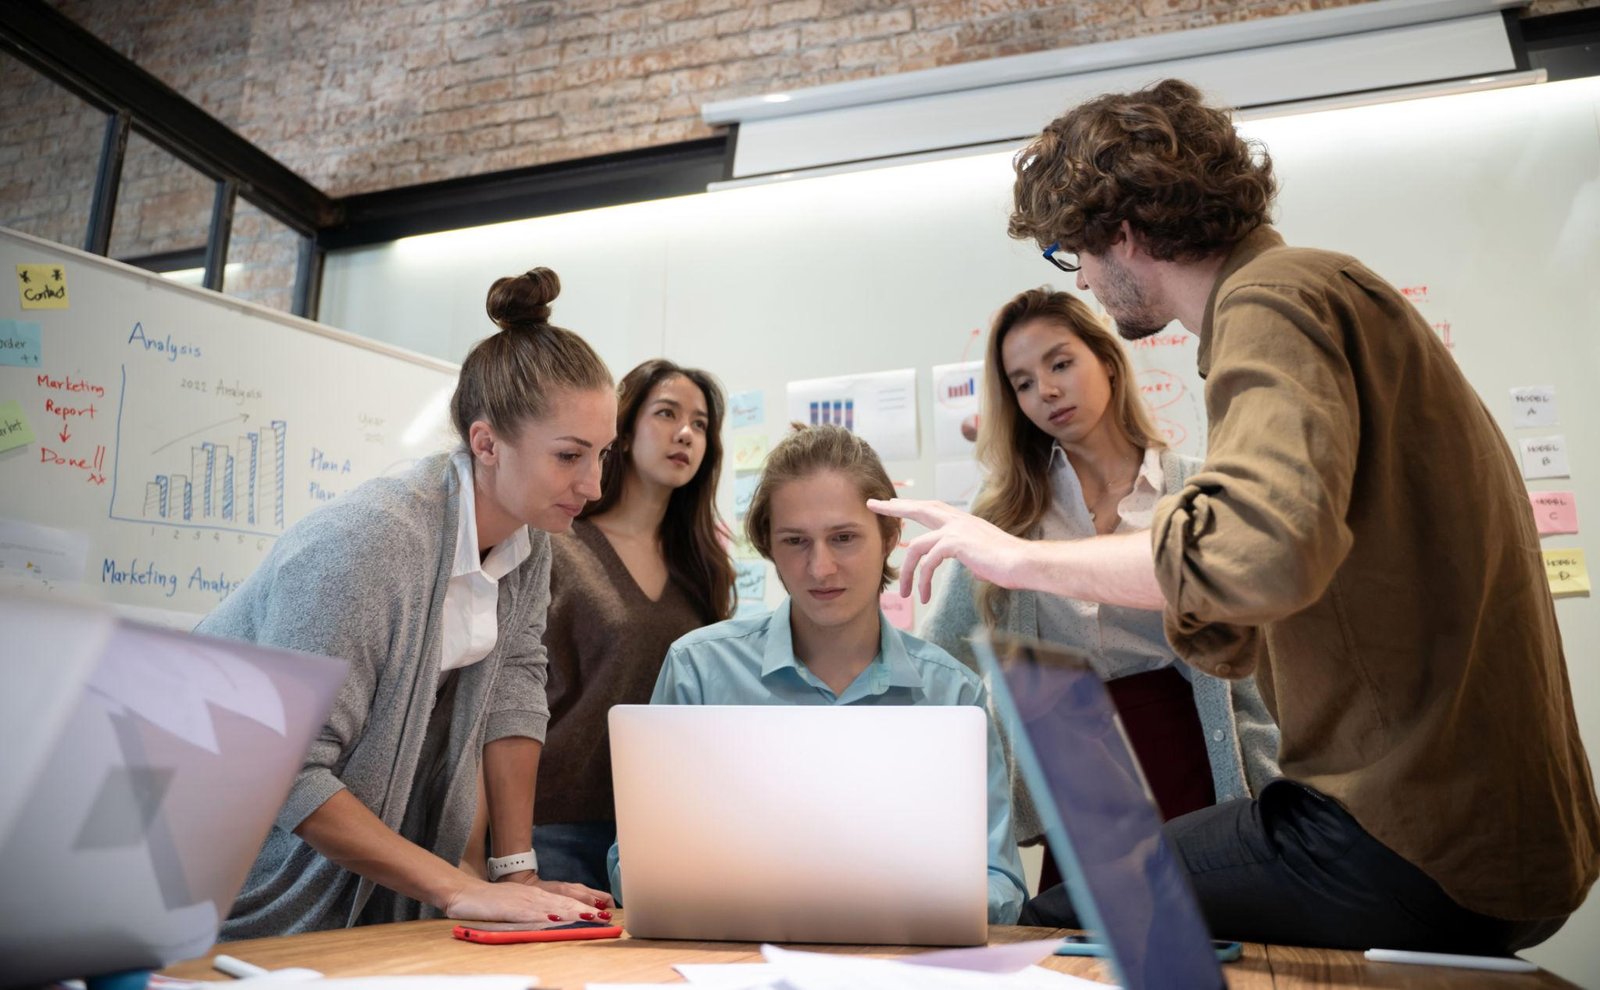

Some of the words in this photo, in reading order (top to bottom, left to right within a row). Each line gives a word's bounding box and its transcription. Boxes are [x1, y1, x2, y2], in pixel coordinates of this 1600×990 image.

[24, 286, 65, 301] Contact
[128, 321, 202, 361] Analysis
[37, 374, 104, 397] Marketing
[215, 378, 262, 406] Analysis
[45, 398, 97, 420] Report
[1515, 394, 1549, 403] MODEL
[1527, 407, 1537, 416] A
[310, 447, 338, 471] Plan
[341, 459, 351, 475] A
[1548, 511, 1559, 520] C
[102, 558, 177, 598] Marketing
[187, 566, 244, 602] Analys
